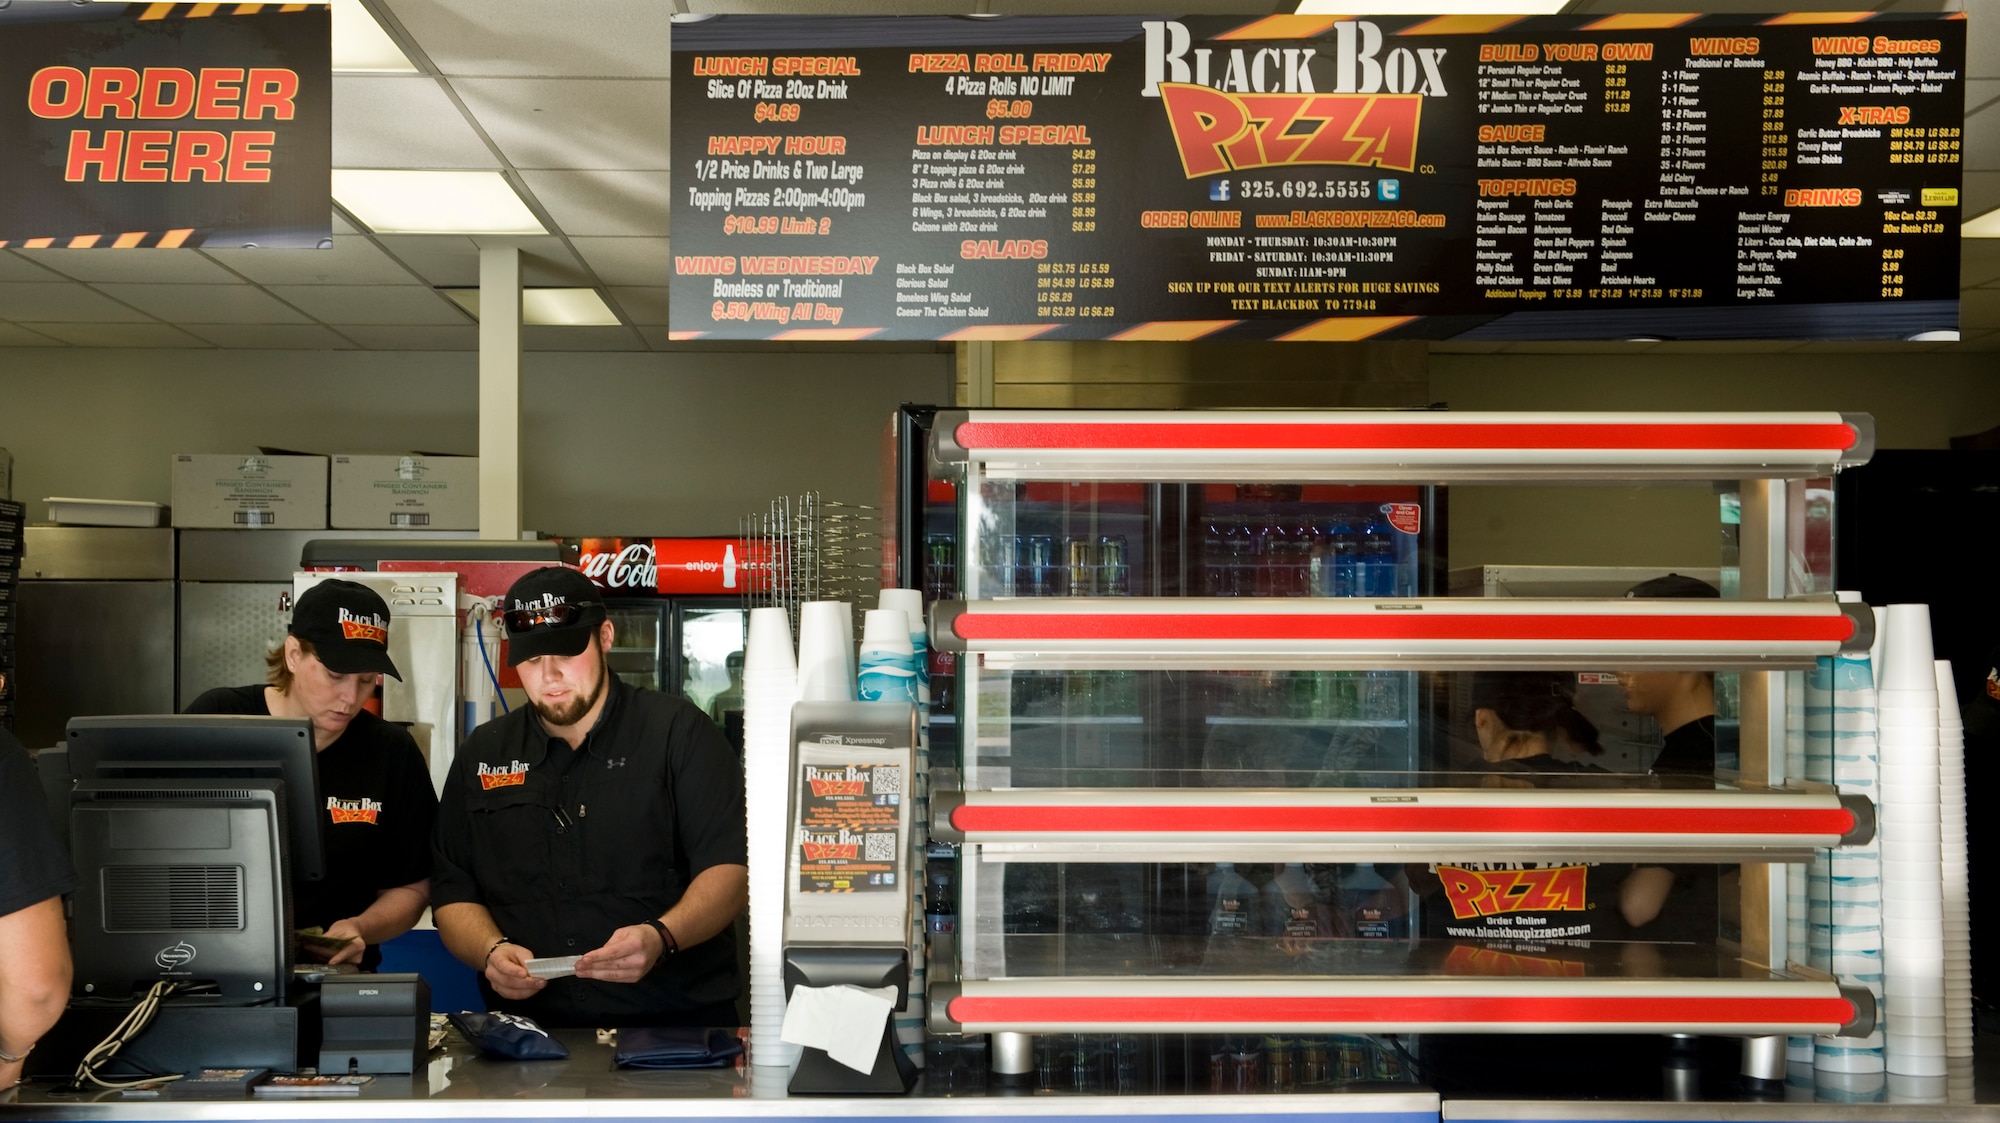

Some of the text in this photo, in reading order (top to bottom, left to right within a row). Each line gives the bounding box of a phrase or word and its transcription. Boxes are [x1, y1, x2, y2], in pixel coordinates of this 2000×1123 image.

[1479, 43, 1653, 62] BUILD YOUR OWN
[1690, 38, 1759, 55] WINGS
[1812, 36, 1941, 54] WING Sauces
[694, 57, 860, 76] LUNCH SPECIAL
[908, 53, 1112, 72] PIZZA ROLL FRIDAY
[1141, 21, 1448, 97] BLACK BOX
[28, 66, 299, 120] ORDER
[707, 79, 848, 99] Slice Of Pizza 20oz Drink
[946, 76, 1075, 95] 4 Pizza Rolls NO LIMIT
[754, 104, 800, 122] $4.69
[986, 100, 1032, 119] $5.00
[1838, 106, 1910, 125] X-TRAS
[917, 125, 1091, 145] LUNCH SPECIAL
[1157, 82, 1424, 179] PIZZA
[1478, 125, 1545, 142] SAUCE
[708, 136, 846, 155] HAPPY HOUR
[1072, 149, 1095, 160] $4.29
[64, 130, 276, 183] HERE
[912, 150, 1016, 162] Pizza on display & 20oz drink
[695, 160, 863, 185] 1/2 Price Drinks & Two Large
[1420, 165, 1437, 174] CO.
[1241, 181, 1370, 198] 325.692.5555
[1478, 178, 1576, 196] TOPPINGS
[689, 187, 865, 212] Topping Pizzas 2:00pm-4:00pm
[1477, 200, 1509, 210] Pepperoni
[1784, 188, 1862, 206] DRINKS
[724, 216, 831, 235] $10.99 Limit 2
[1141, 211, 1241, 228] ORDER ONLINE
[1256, 210, 1446, 228] www.BLACKBOXPIZZACO.com
[960, 240, 1048, 259] SALADS
[1207, 237, 1245, 246] MONDAY
[1255, 237, 1308, 246] THURSDAY:
[1314, 237, 1396, 246] 10:30AM-10:30PM
[675, 256, 879, 275] WING WEDNESDAY
[1210, 252, 1244, 262] FRIDAY
[1254, 252, 1307, 262] SATURDAY:
[1312, 252, 1393, 262] 10:30AM-11:30PM
[896, 264, 954, 274] Black Box Salad
[1038, 263, 1109, 274] SM $3.75 LG 5.59
[1256, 268, 1346, 277] SUNDAY: 11AM-9PM
[713, 278, 842, 298] Boneless or Traditional
[1168, 282, 1439, 293] SIGN UP FOR OUR TEXT ALERTS FOR HUGE SAVINGS
[712, 302, 843, 325] $.50/Wing All Day
[1231, 300, 1376, 310] TEXT BLACKBOX TO 77948
[686, 560, 718, 572] enjoy
[820, 736, 886, 745] TORK Xpressnap
[806, 766, 871, 782] BLACK BOX
[1435, 865, 1588, 920] PIZZA
[794, 914, 900, 928] NAPKINS
[1486, 916, 1547, 926] Order Online
[1446, 924, 1590, 940] www.blackboxpizzaco.com
